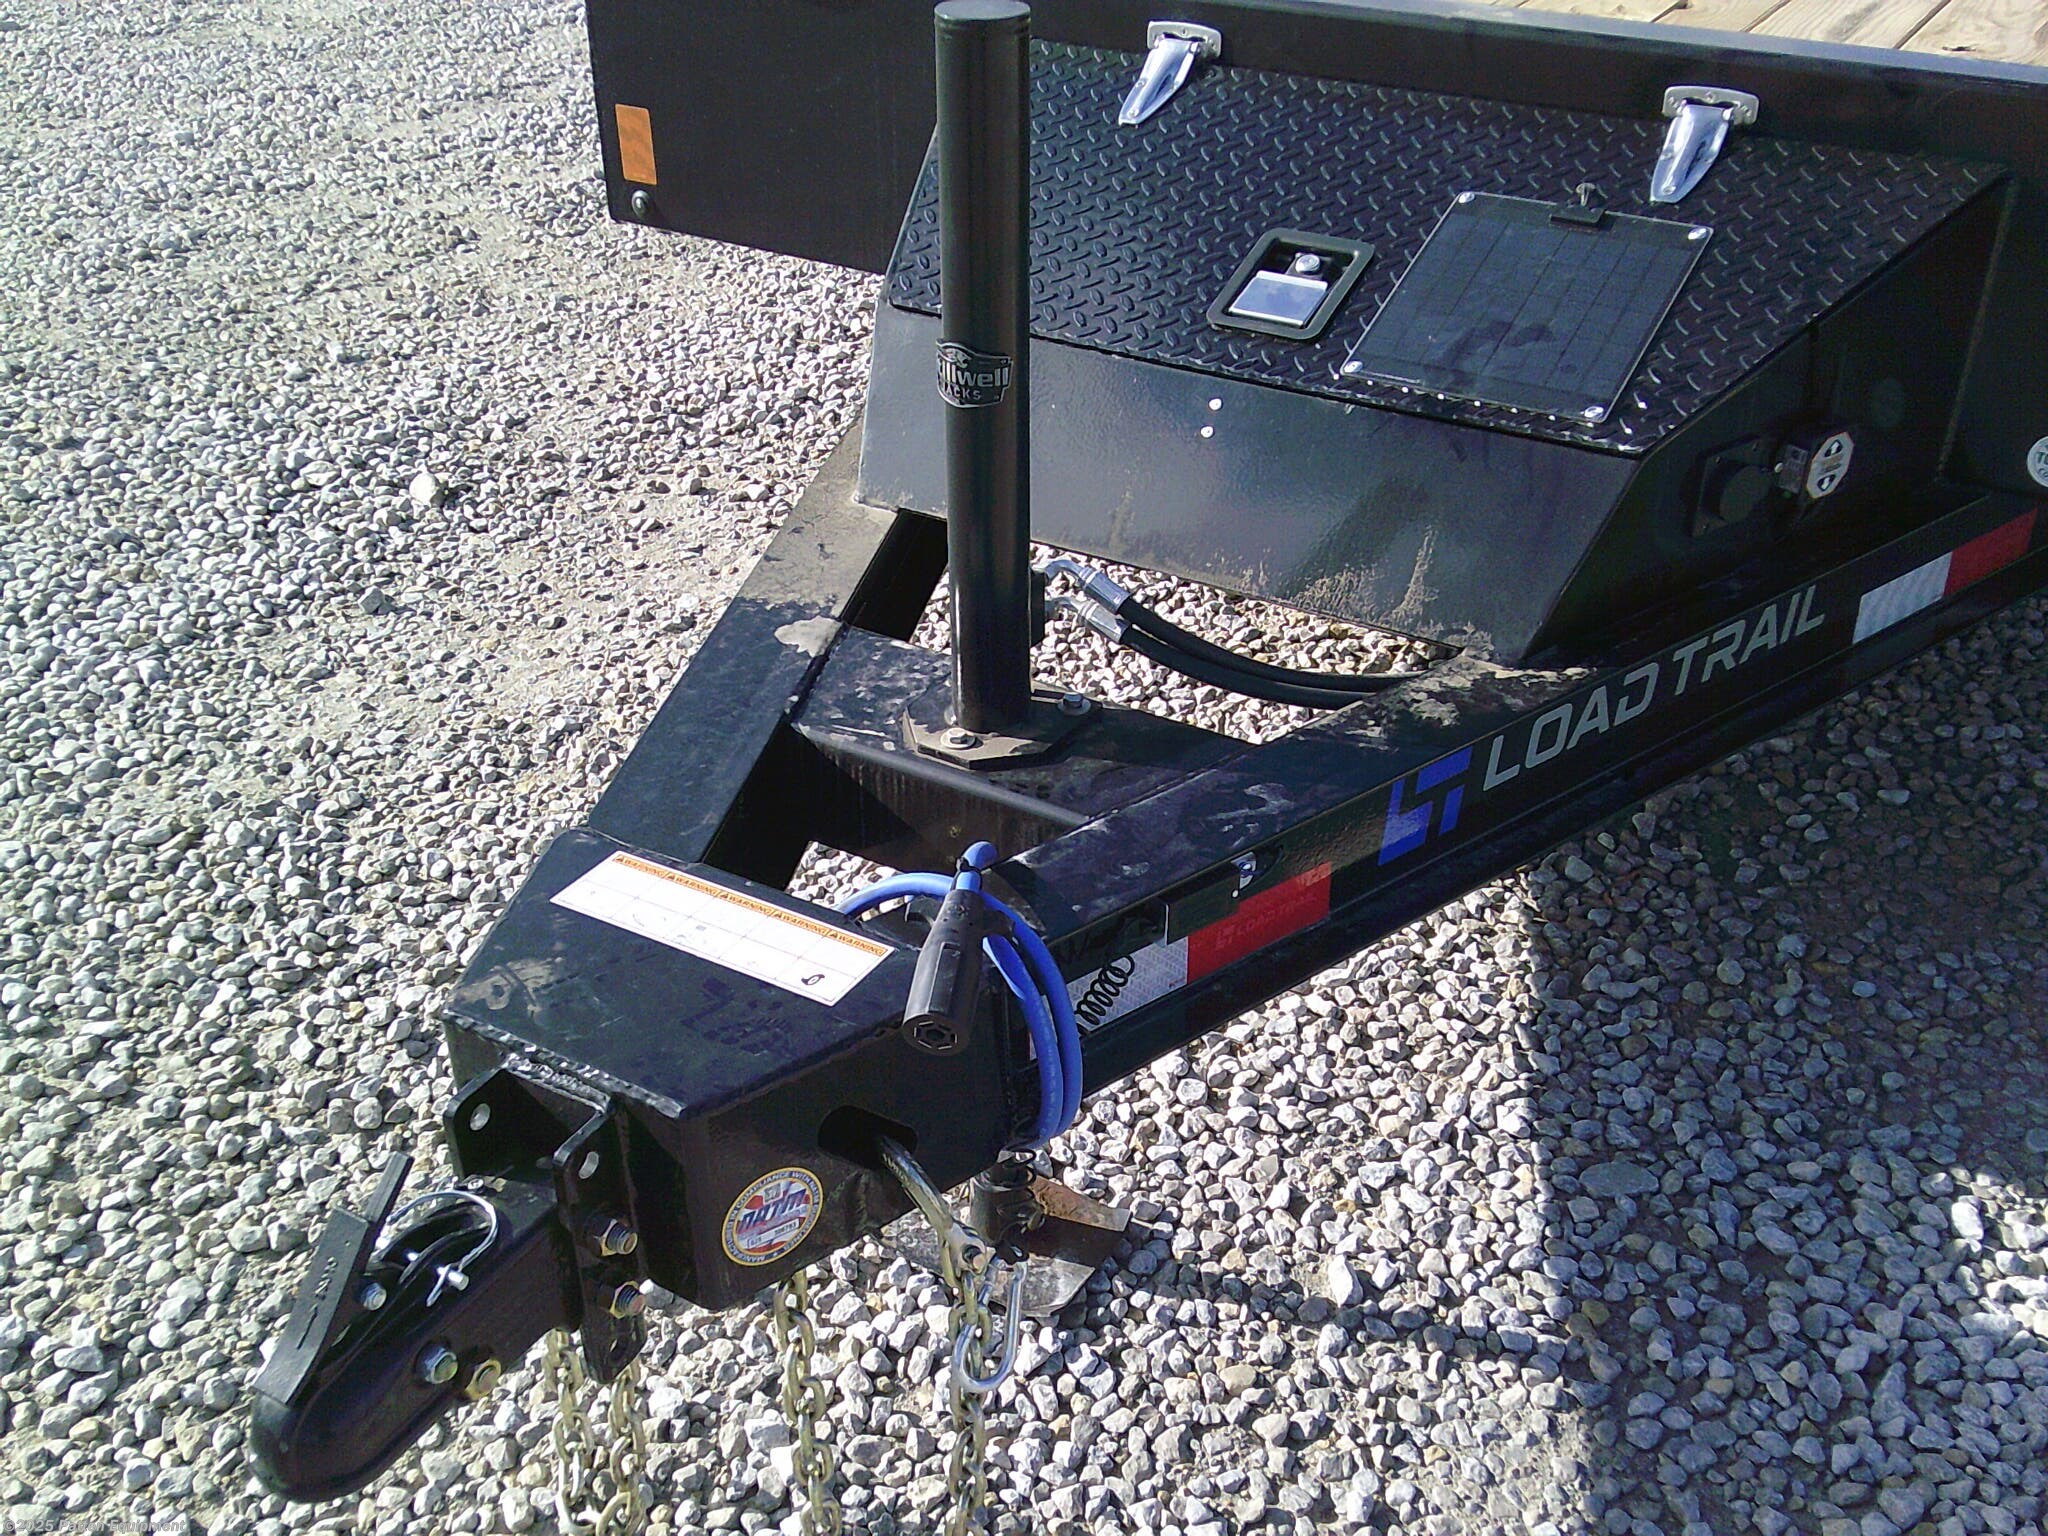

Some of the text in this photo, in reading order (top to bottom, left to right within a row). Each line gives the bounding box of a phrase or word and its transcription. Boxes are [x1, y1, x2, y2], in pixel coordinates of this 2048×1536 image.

[1483, 584, 1827, 792] LOAD TRAIL
[675, 875, 719, 897] WARNING
[726, 893, 771, 915] WARNING
[779, 912, 828, 935] WARNING
[837, 932, 886, 956] WARNING
